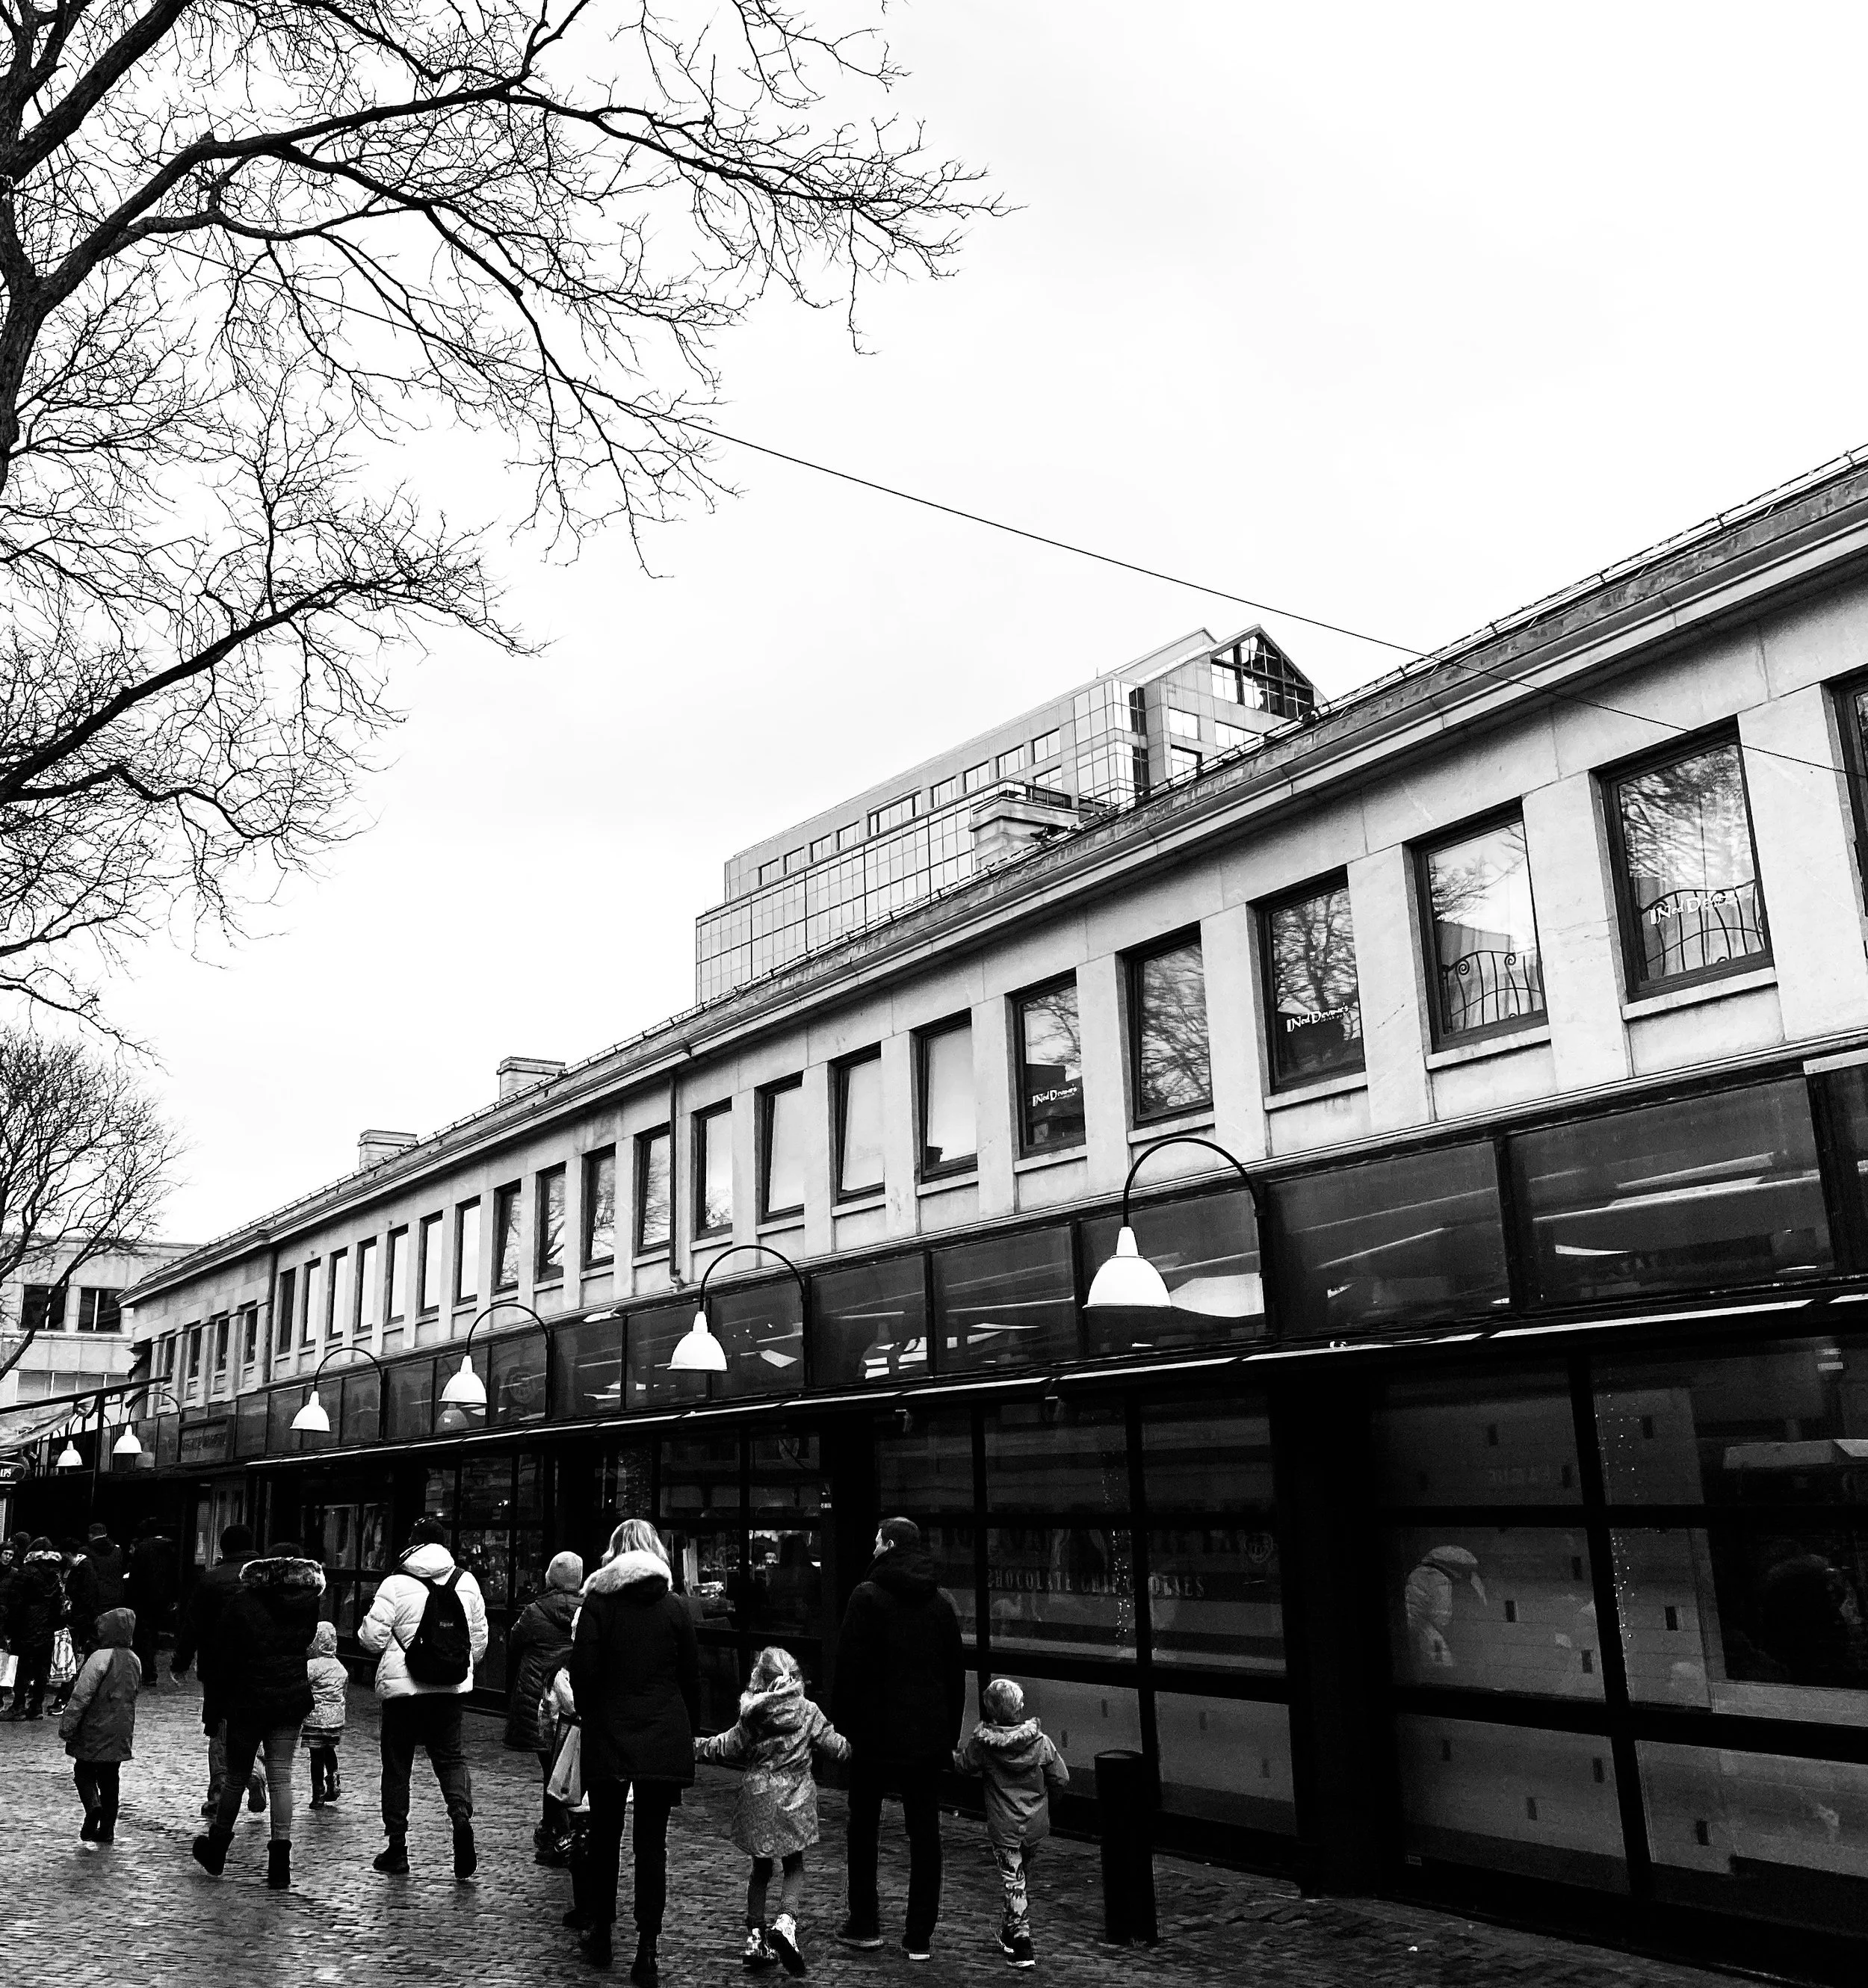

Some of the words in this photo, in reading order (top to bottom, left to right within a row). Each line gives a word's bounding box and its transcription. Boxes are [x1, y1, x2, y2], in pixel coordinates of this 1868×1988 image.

[1649, 899, 1684, 925] Ned
[1286, 1012, 1311, 1032] Ned
[1126, 1575, 1205, 1598] COKIES
